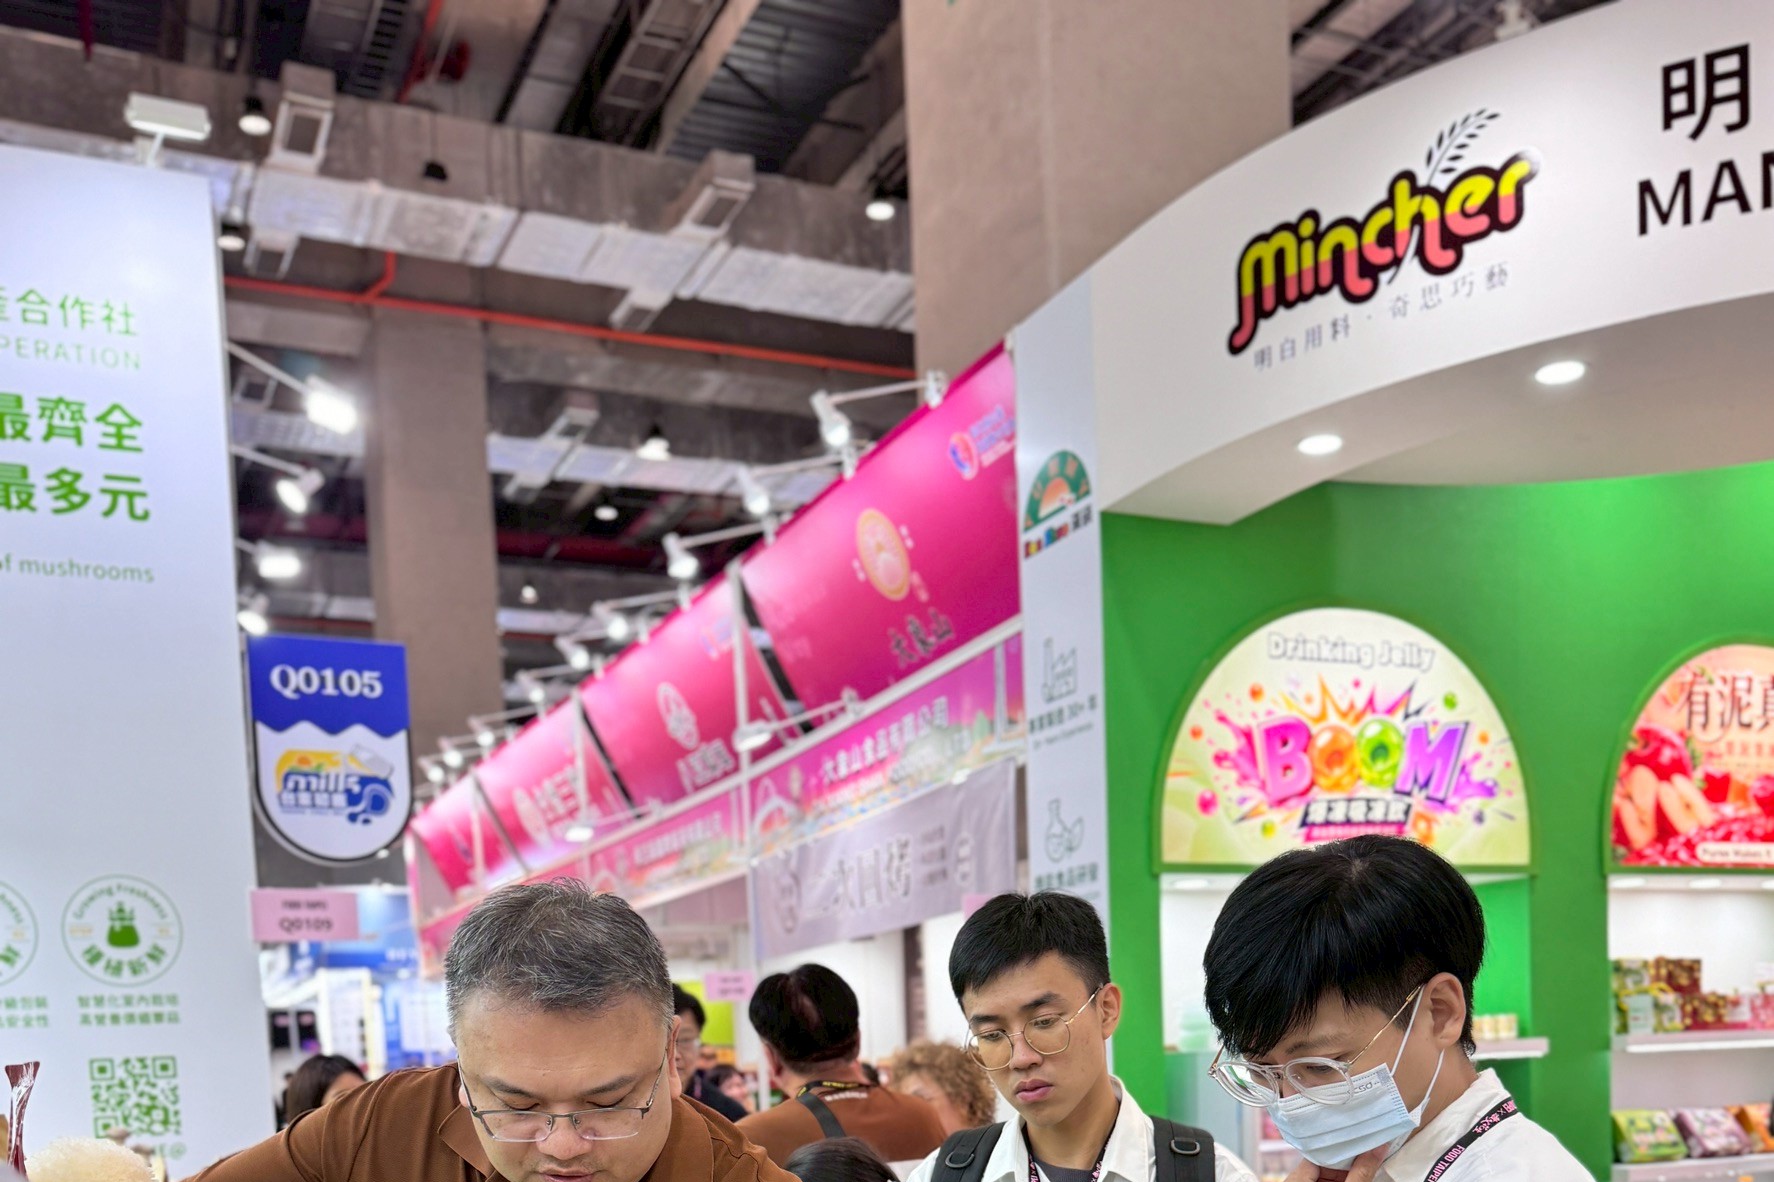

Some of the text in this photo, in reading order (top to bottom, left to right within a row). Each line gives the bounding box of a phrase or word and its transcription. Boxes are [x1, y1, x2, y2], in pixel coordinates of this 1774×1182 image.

[1660, 43, 1751, 141] 明
[1637, 149, 1774, 237] MA
[0, 287, 136, 336] 合作社
[19, 556, 154, 583] mushrooms
[1267, 630, 1436, 672] Drinking Jelly
[269, 664, 384, 700] Q0105
[1256, 715, 1470, 805] BOOM
[1448, 1144, 1466, 1163] FOOD
